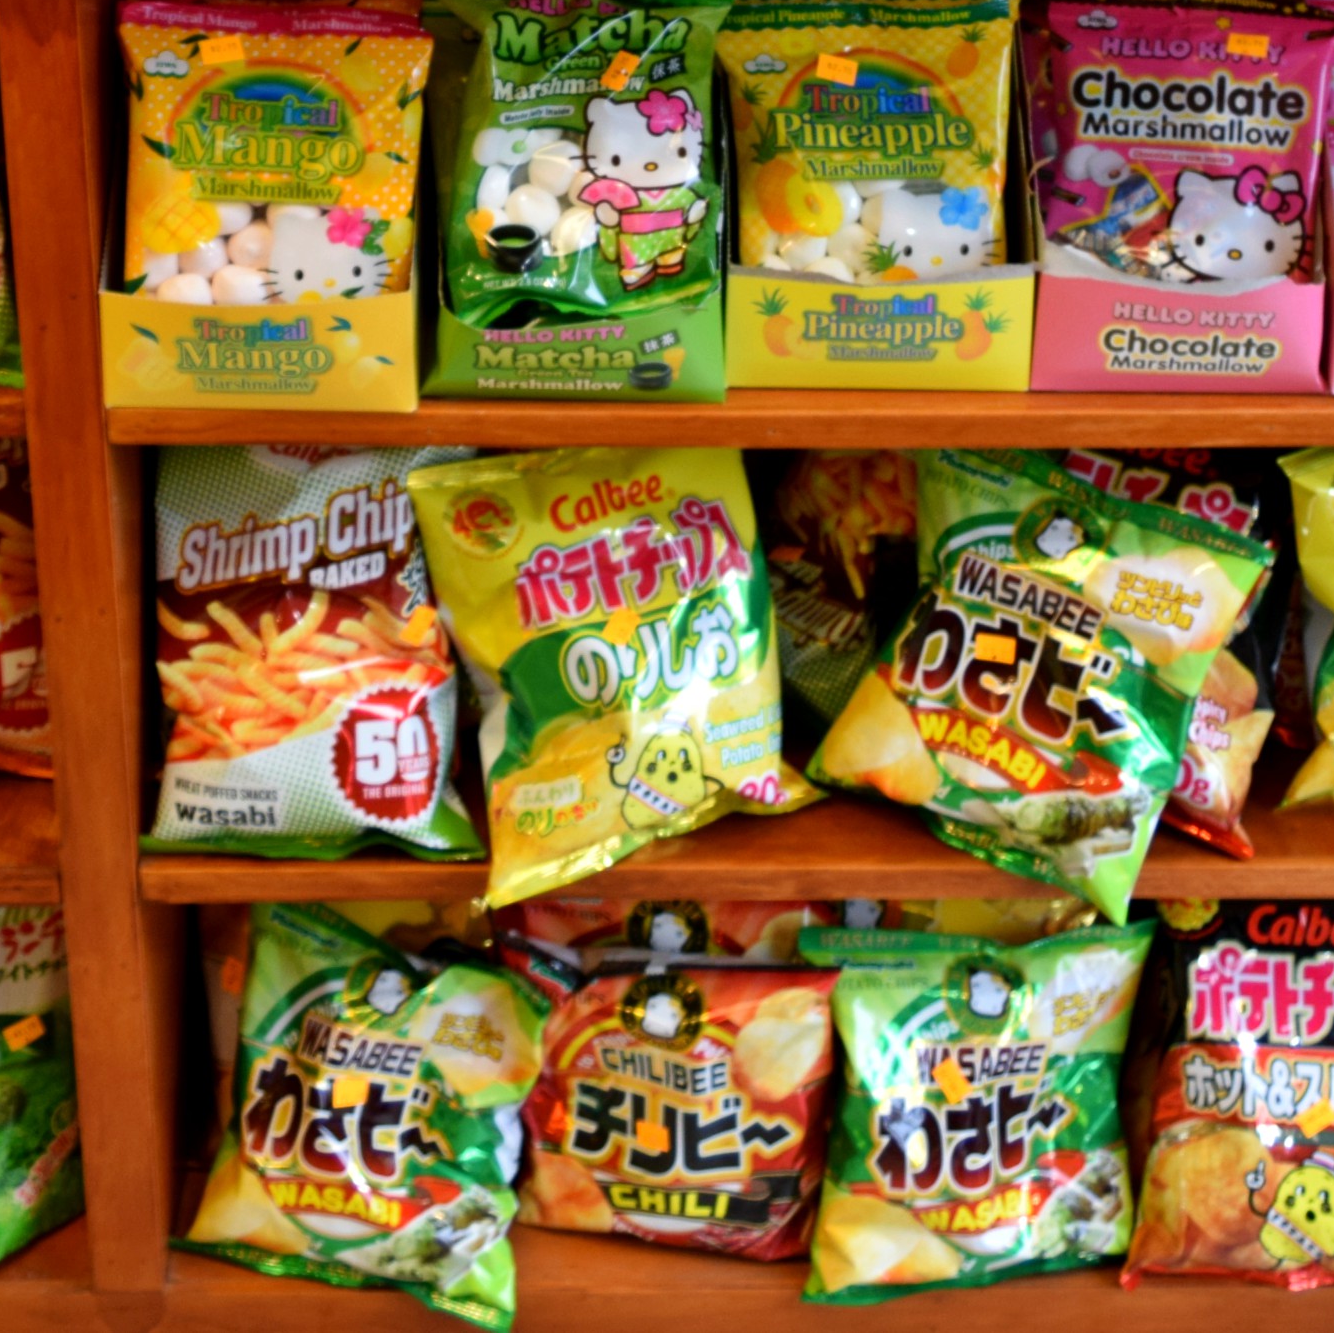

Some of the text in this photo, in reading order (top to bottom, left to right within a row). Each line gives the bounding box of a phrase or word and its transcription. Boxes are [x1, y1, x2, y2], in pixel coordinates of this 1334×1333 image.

[495, 12, 692, 66] Matcha
[1102, 37, 1191, 59] HELLO
[203, 93, 339, 128] Tropical
[804, 85, 933, 114] Tropical
[1073, 71, 1305, 121] Chocolate
[175, 121, 364, 180] Mango
[773, 112, 969, 153] Pineapple
[807, 158, 944, 178] Marshmallow
[195, 176, 338, 201] Marshmallow
[483, 326, 626, 343] HELLO KITTY
[1103, 329, 1277, 359] Chocolate
[476, 343, 637, 370] Matcha
[180, 514, 316, 590] Shrimp
[308, 551, 386, 589] BAKED
[956, 555, 1106, 640] WASABEE
[917, 711, 1047, 790] WASABI
[175, 800, 276, 827] wasabi
[299, 1016, 423, 1078] WASABEE
[601, 1047, 729, 1094] CHILIBEE
[269, 1181, 403, 1228] WASABI
[609, 1184, 730, 1219] CHILI
